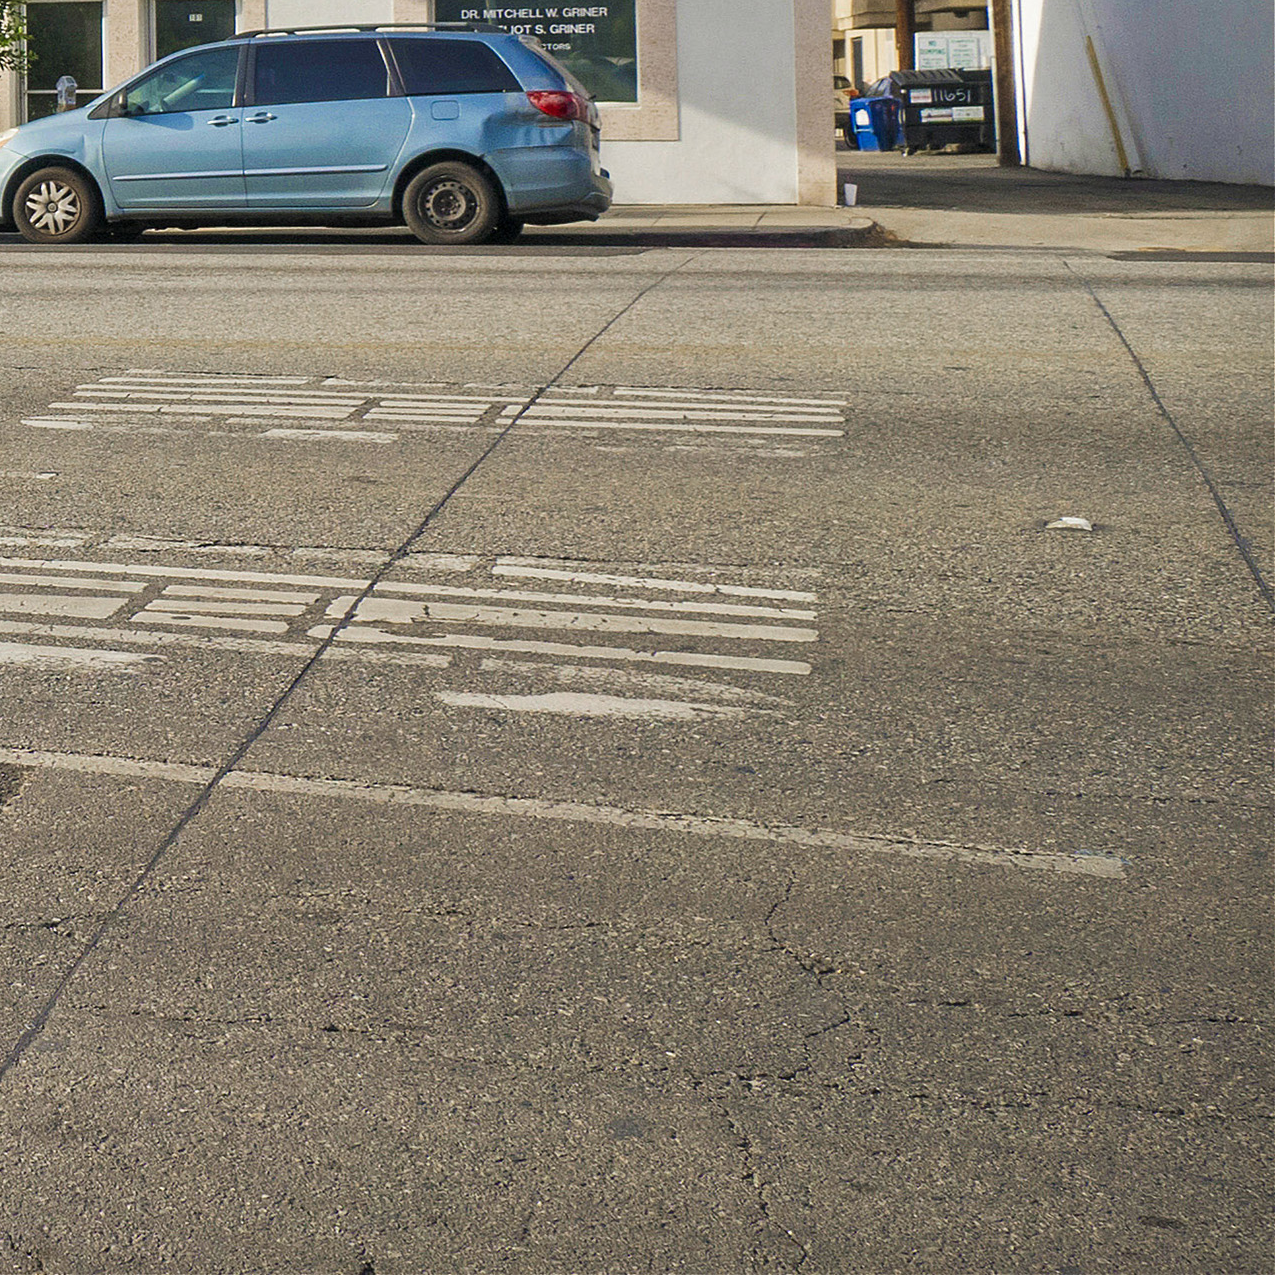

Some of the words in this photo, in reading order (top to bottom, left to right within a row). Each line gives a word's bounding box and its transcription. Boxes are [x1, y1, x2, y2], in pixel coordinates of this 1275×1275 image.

[461, 9, 480, 19] DR.
[483, 8, 543, 19] MITCHELL
[545, 8, 559, 17] W.
[562, 7, 607, 17] GRINER
[535, 24, 546, 34] S.
[550, 24, 595, 34] GRINER
[934, 89, 970, 102] 11651
